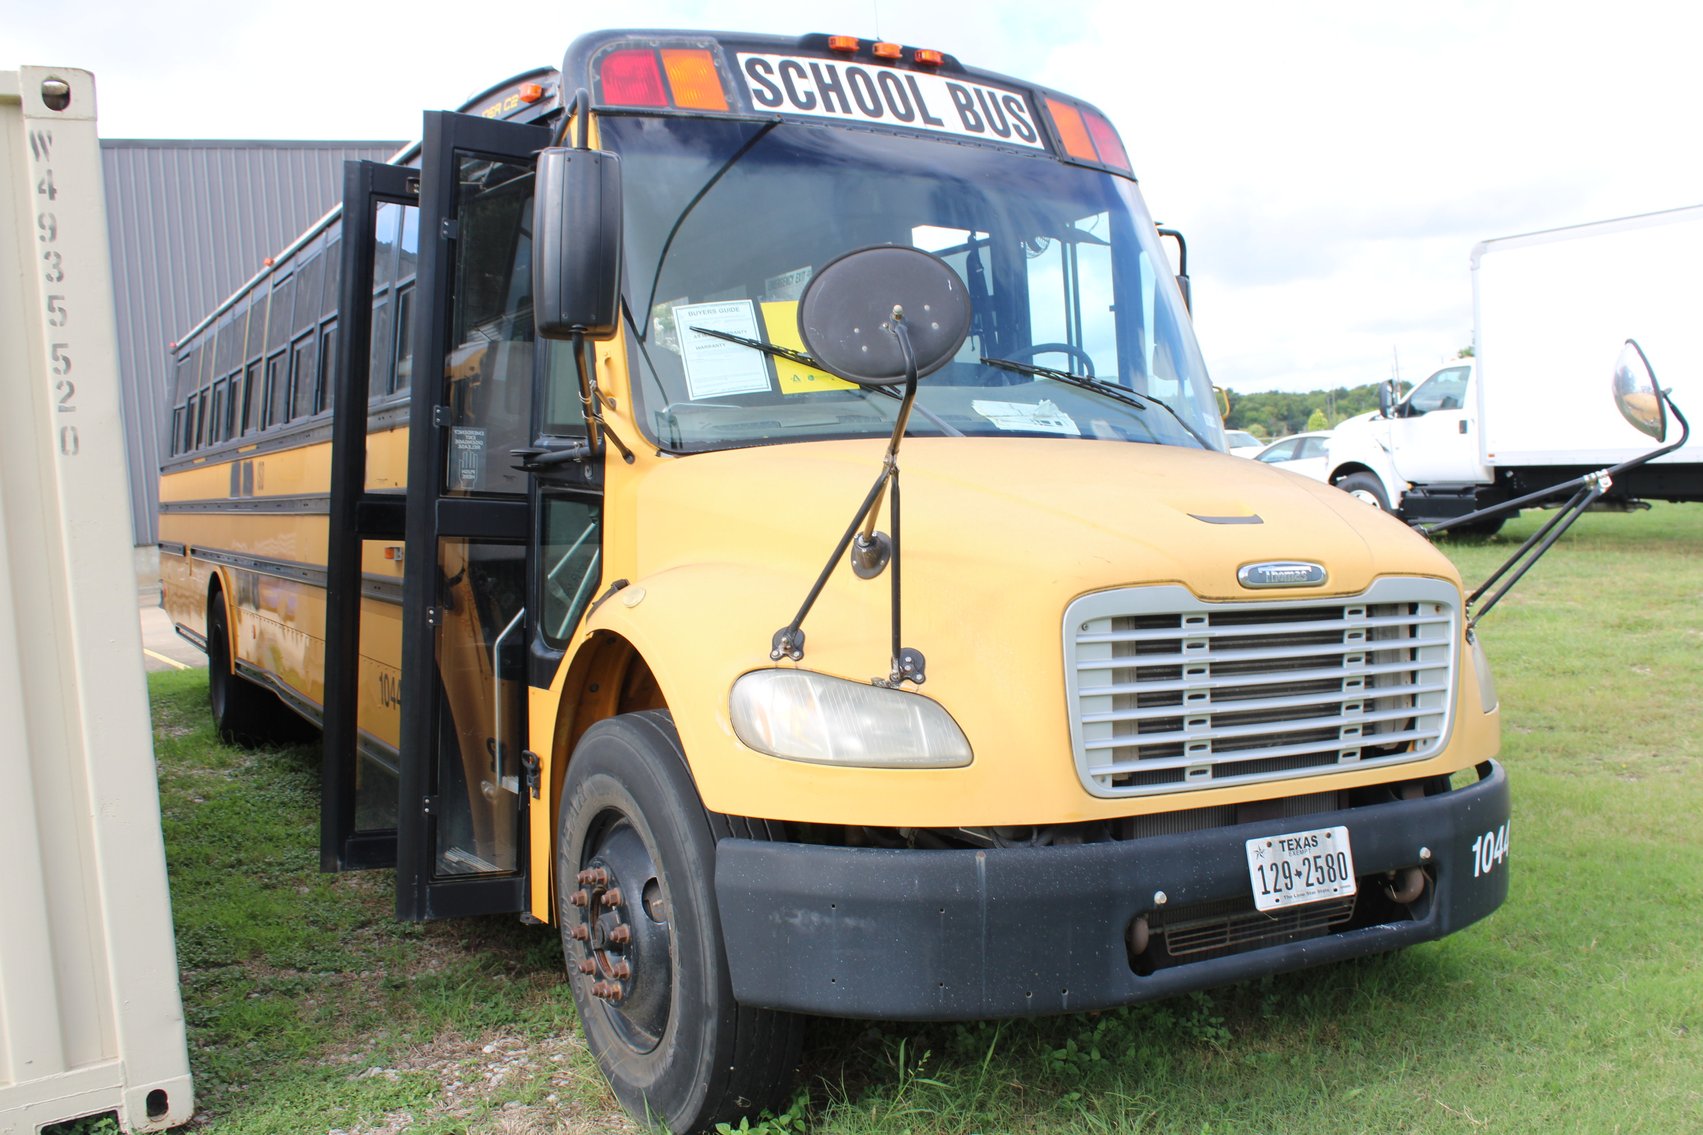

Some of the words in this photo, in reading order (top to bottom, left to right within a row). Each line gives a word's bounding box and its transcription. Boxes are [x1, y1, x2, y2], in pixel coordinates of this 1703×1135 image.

[504, 94, 519, 111] C2
[745, 57, 944, 128] SCHOOL
[945, 81, 1038, 144] BUS
[688, 309, 717, 317] BUYERS
[1279, 835, 1319, 852] TEXAS
[1288, 848, 1312, 857] EXEMPT
